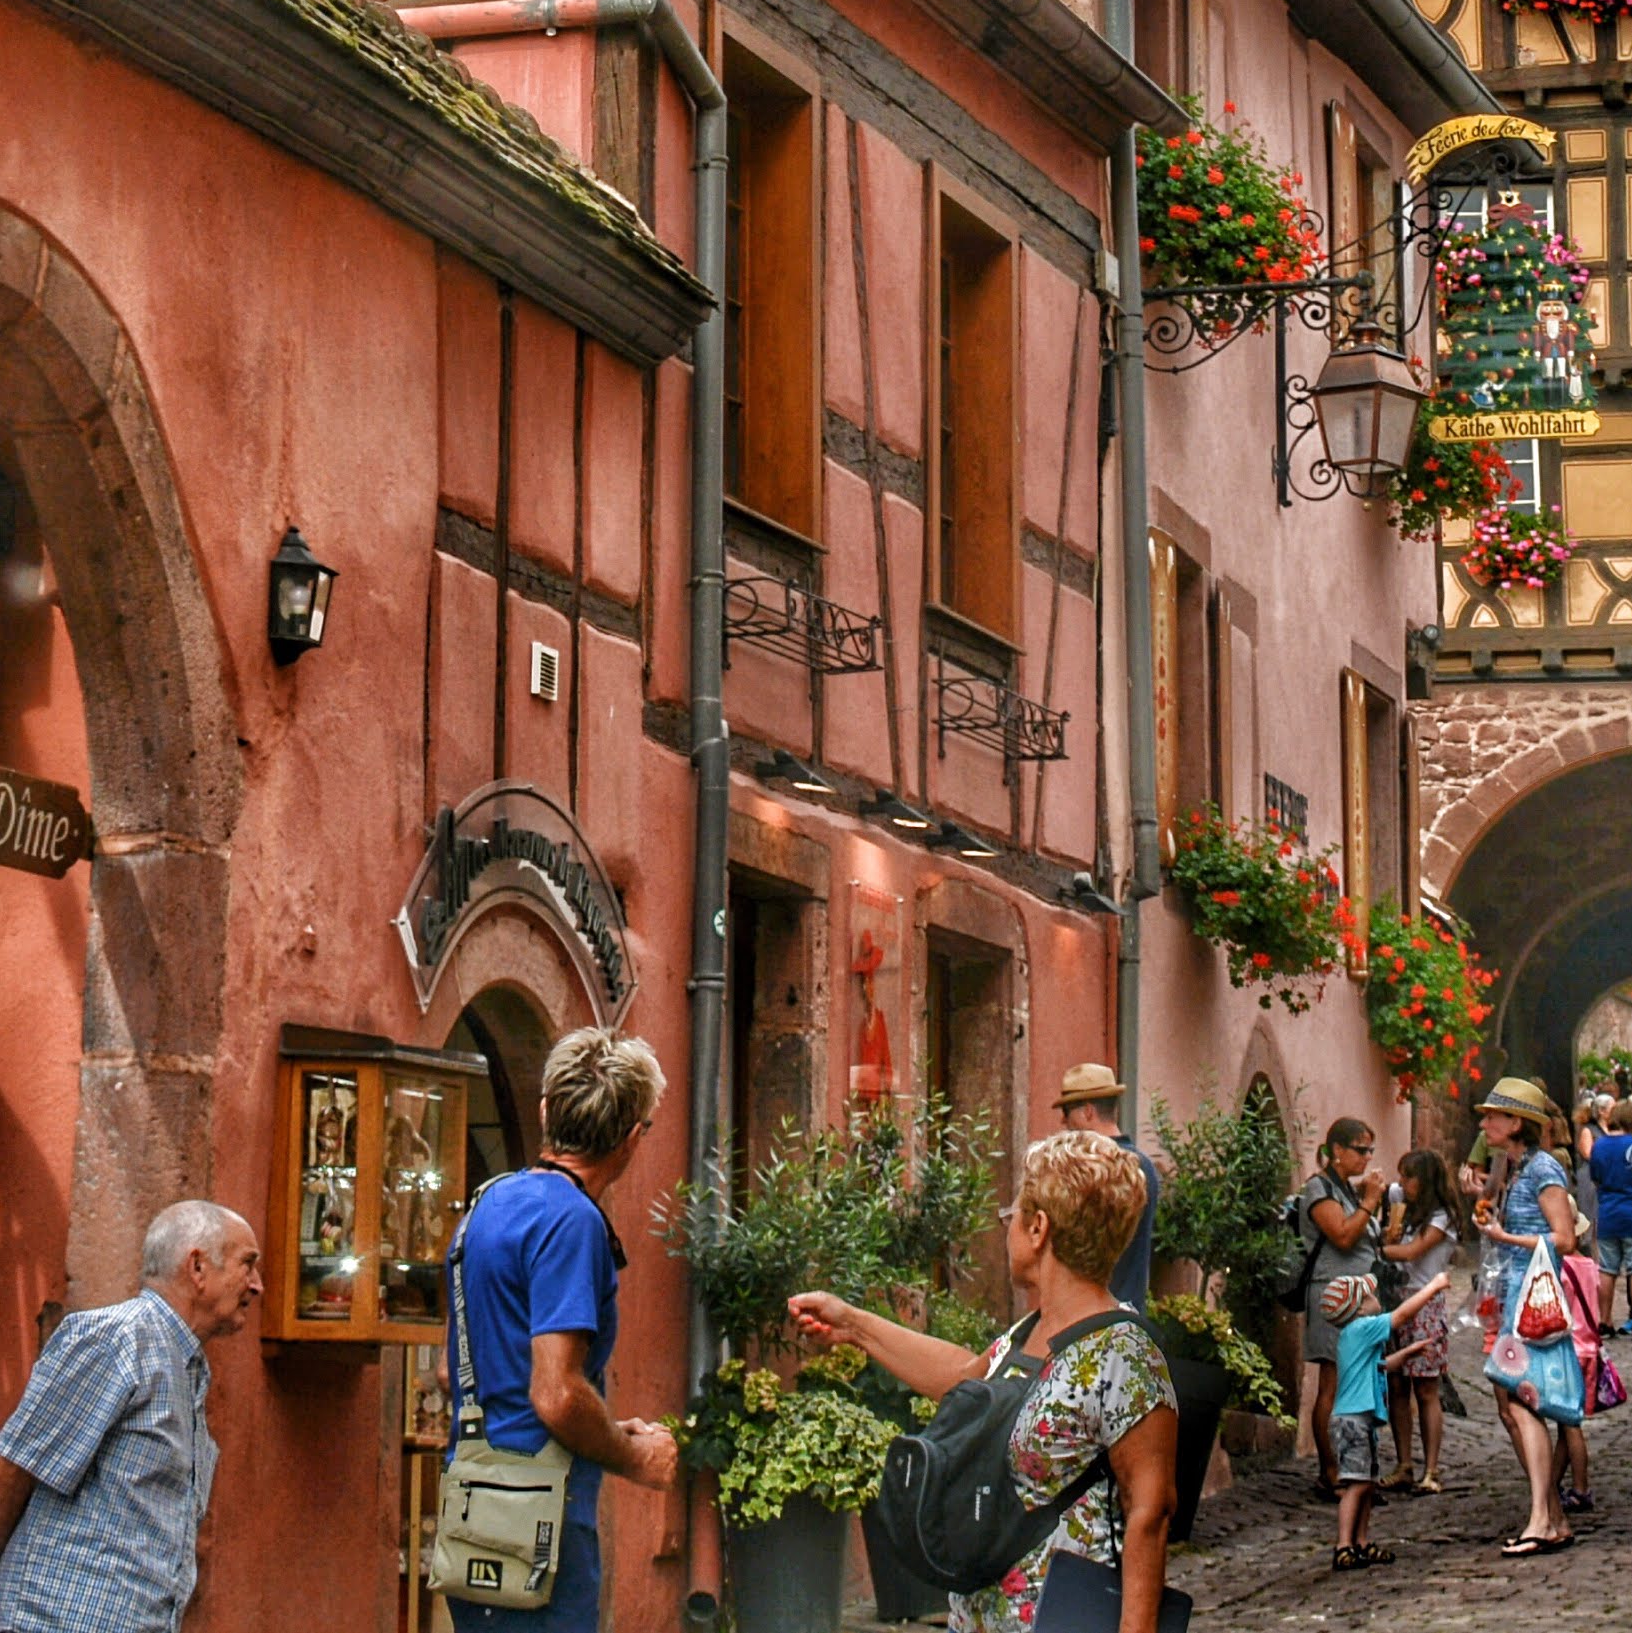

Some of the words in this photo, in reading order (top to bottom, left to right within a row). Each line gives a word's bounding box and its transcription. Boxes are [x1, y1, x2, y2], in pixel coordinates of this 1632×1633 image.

[1471, 118, 1488, 138] de
[1444, 416, 1495, 438] Käthe
[1500, 414, 1586, 436] Wohlfahrt
